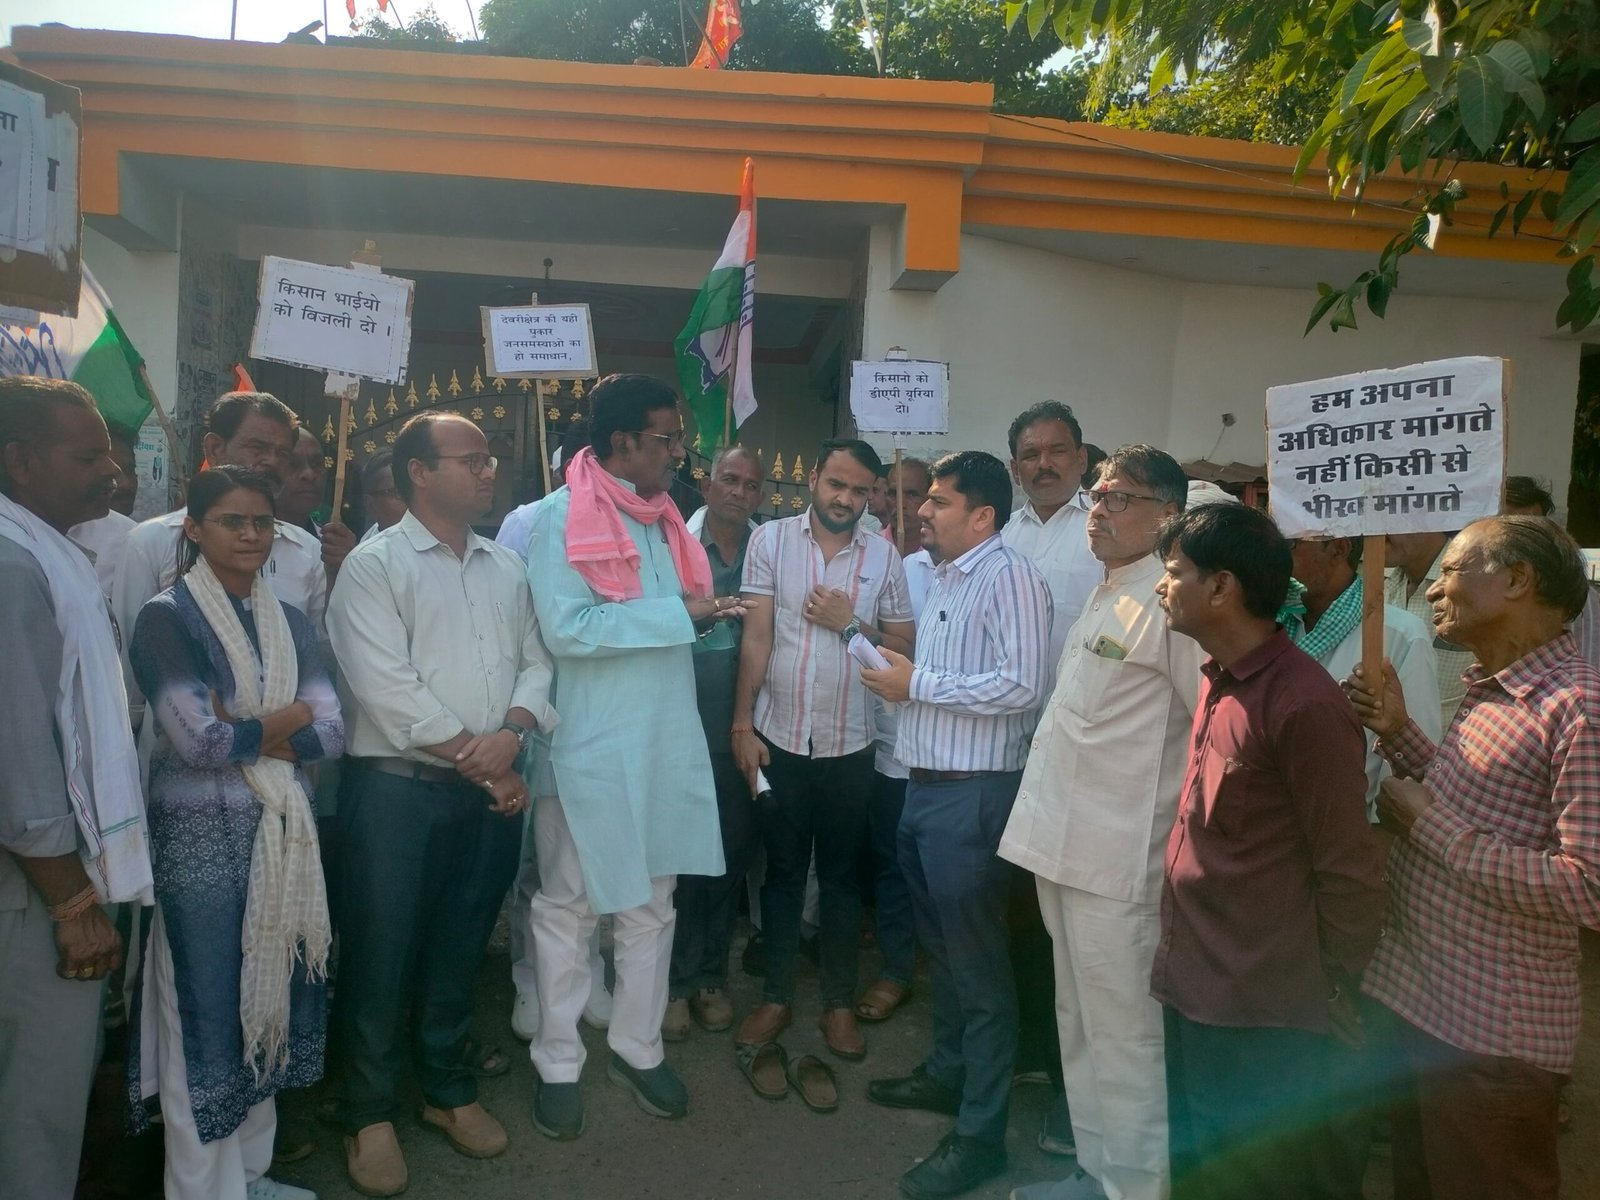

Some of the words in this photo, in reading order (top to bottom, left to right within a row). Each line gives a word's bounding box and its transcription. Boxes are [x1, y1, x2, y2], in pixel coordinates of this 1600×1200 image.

[278, 278, 326, 301] किसान
[334, 291, 381, 312] भाईयो
[274, 299, 293, 317] को
[360, 315, 377, 335] दो
[529, 328, 553, 338] पुकार
[545, 313, 556, 323] की
[561, 313, 578, 323] यही
[514, 350, 524, 361] हो
[874, 371, 910, 383] किसानो
[915, 371, 928, 383] को
[1310, 388, 1354, 413] हम
[1360, 375, 1455, 406] अपना
[869, 387, 900, 401] डीएपी
[905, 387, 934, 402] यूरिया
[1278, 420, 1395, 452] अधिकार
[1401, 403, 1496, 437] मांगते
[1295, 454, 1351, 485] नहीं
[1354, 449, 1436, 480] किसी
[1441, 444, 1472, 473] से
[1302, 494, 1368, 519] भीख
[1372, 484, 1463, 515] मांगते
